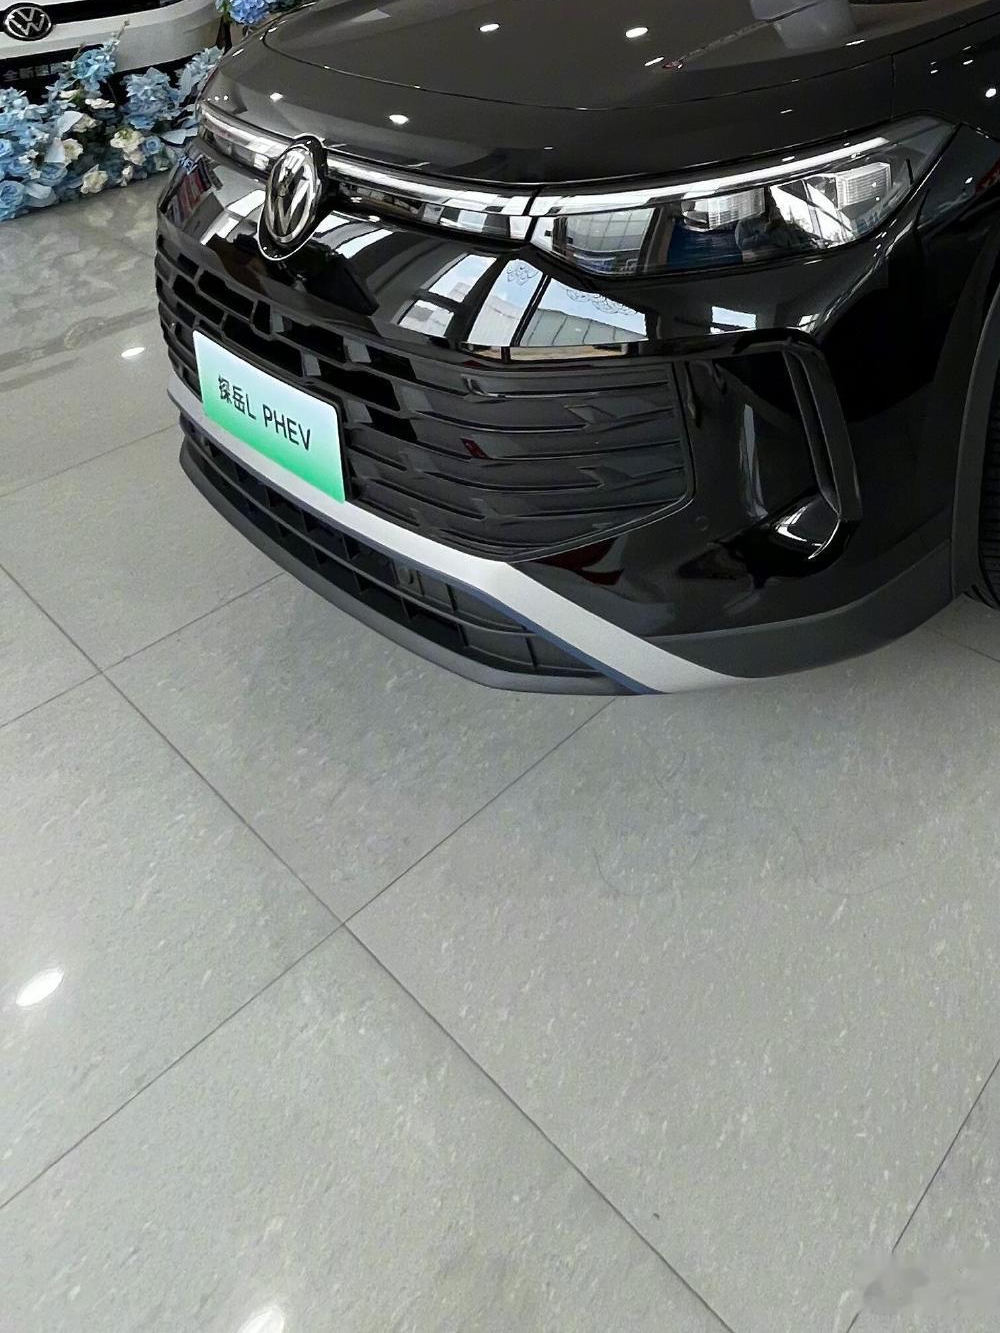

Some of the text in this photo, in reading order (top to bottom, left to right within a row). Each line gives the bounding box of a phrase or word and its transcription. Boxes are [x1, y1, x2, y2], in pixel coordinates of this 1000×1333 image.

[4, 6, 52, 39] VW
[218, 374, 311, 451] 探岳L PHEV
